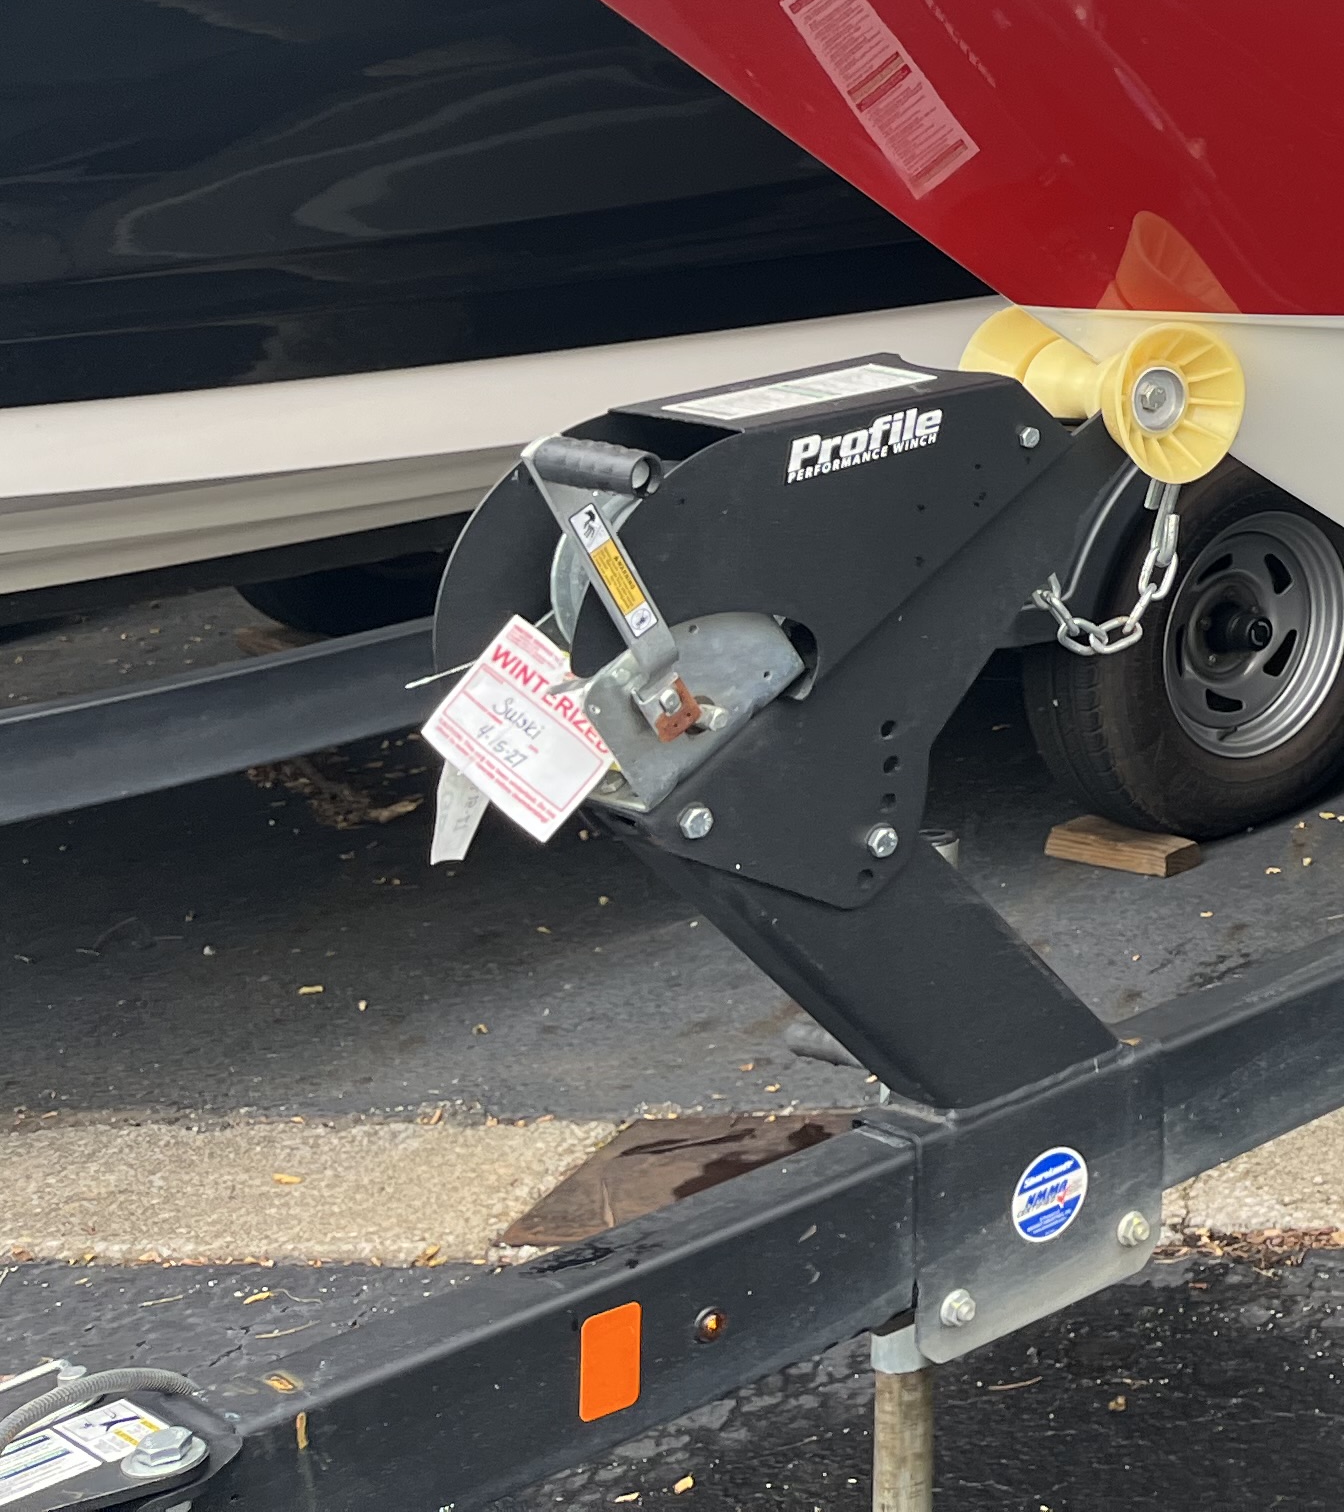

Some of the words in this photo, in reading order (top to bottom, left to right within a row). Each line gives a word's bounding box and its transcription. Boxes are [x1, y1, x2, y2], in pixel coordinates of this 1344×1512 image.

[786, 445, 889, 484] PERFORMANCE
[892, 432, 938, 455] WINCH
[787, 407, 943, 473] Profile
